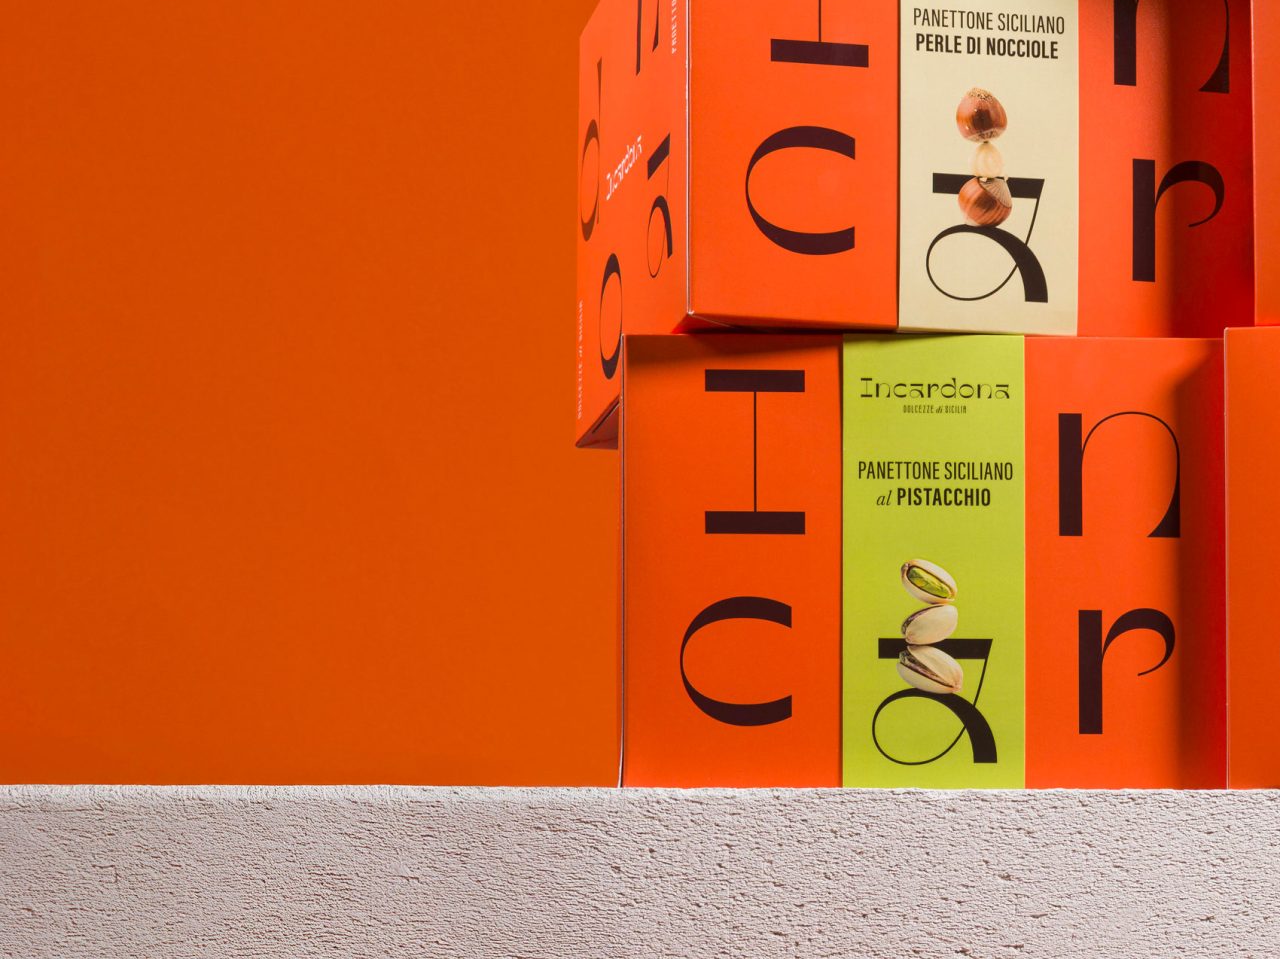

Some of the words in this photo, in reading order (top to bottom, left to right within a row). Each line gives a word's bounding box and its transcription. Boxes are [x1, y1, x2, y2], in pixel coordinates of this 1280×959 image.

[913, 8, 993, 30] PANETTONE
[998, 13, 1064, 34] SICILIANO
[916, 33, 962, 53] PERLE
[967, 36, 981, 55] DI
[986, 37, 1058, 59] NOCCIOLE
[860, 378, 1010, 399] Incardona
[903, 405, 933, 413] DOLCEZZE
[936, 405, 942, 413] di
[945, 405, 967, 413] SICILIA
[858, 461, 940, 479] PANETTONE
[944, 462, 1013, 480] SICILIANO
[877, 490, 892, 506] al
[897, 488, 991, 506] PISTACCHIO
